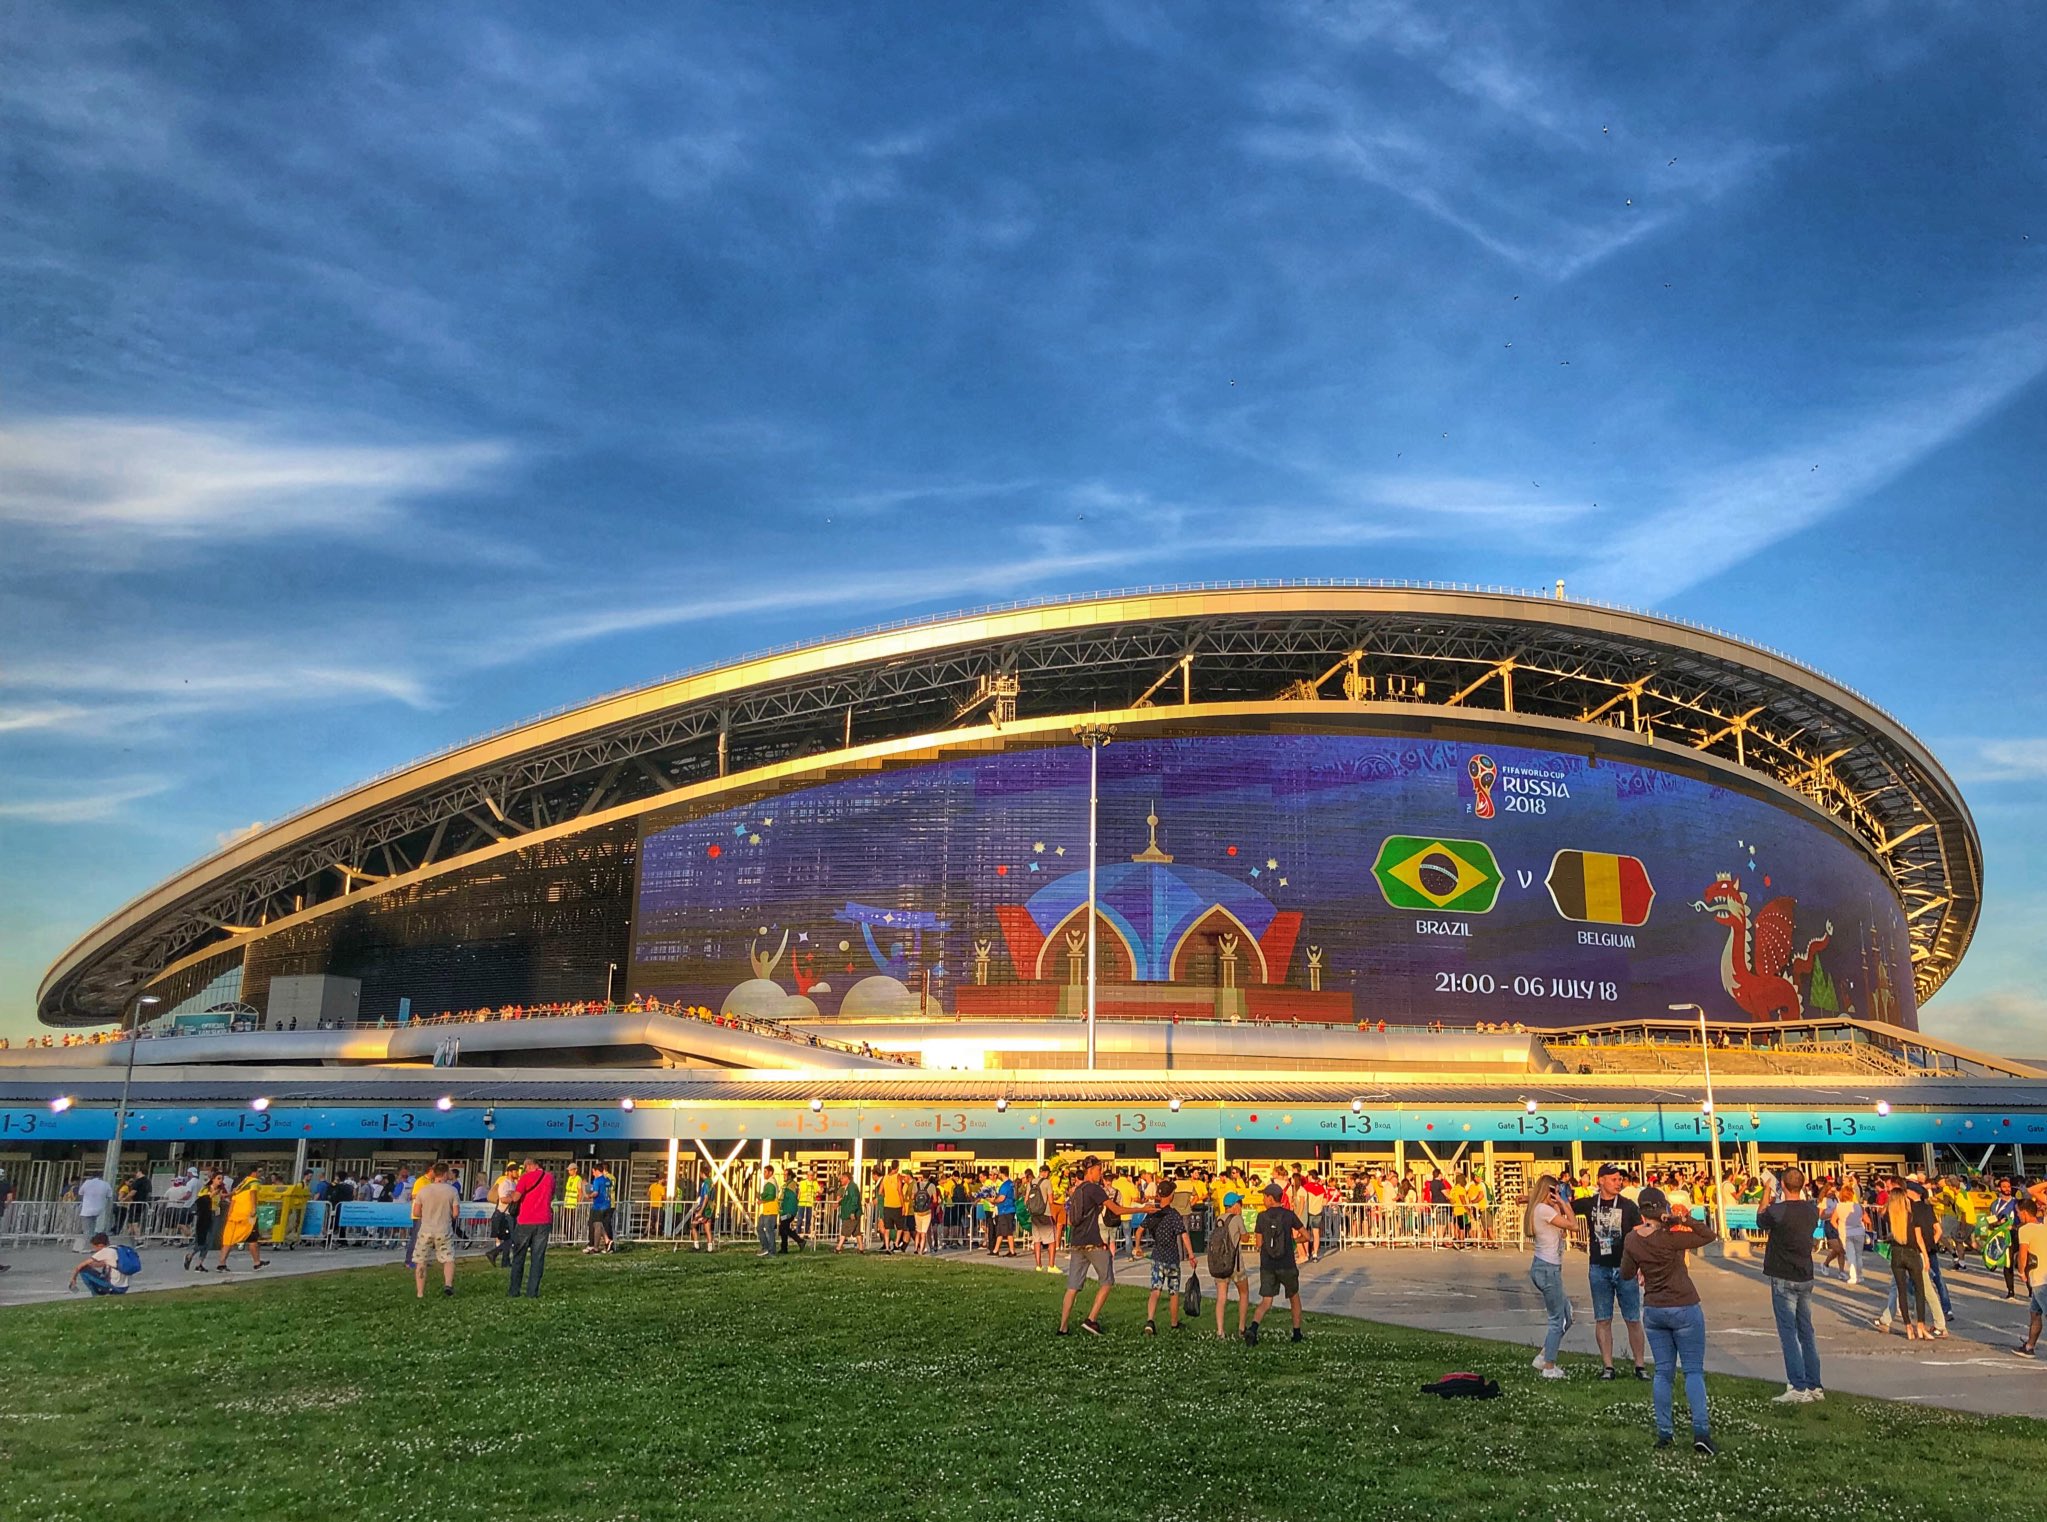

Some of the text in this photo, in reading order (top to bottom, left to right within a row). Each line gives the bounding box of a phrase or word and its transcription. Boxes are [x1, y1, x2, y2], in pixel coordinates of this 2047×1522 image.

[1502, 765, 1566, 780] FIFA WORLD CUP
[1503, 776, 1571, 799] RUSSIA
[1504, 795, 1547, 815] 2018
[1416, 920, 1473, 937] BRAZIL
[1577, 930, 1636, 949] BELGIUM
[1435, 972, 1495, 994] 21:00
[1513, 976, 1545, 997] 06
[1549, 978, 1595, 1000] JULY
[1599, 981, 1619, 1001] 18
[2, 1114, 37, 1133] 1-3
[238, 1114, 271, 1132] 1-3
[274, 1120, 292, 1128] Вход
[382, 1113, 415, 1132] 1-3
[418, 1120, 435, 1129] Вход
[546, 1114, 620, 1133] Gate 1-3 Вход
[796, 1113, 829, 1133] 1-3
[914, 1113, 987, 1132] Gate 1-3 Вход
[1095, 1113, 1167, 1132] Gate 1-3 Вход
[1320, 1115, 1391, 1134] Gate 1-3 Вход
[1498, 1116, 1569, 1135] Gate 1-3 Вход
[1693, 1116, 1725, 1135] 1-3
[1727, 1123, 1744, 1131] Вход
[1806, 1118, 1876, 1135] Gate 1-3 Вход
[2027, 1124, 2045, 1132] Gate
